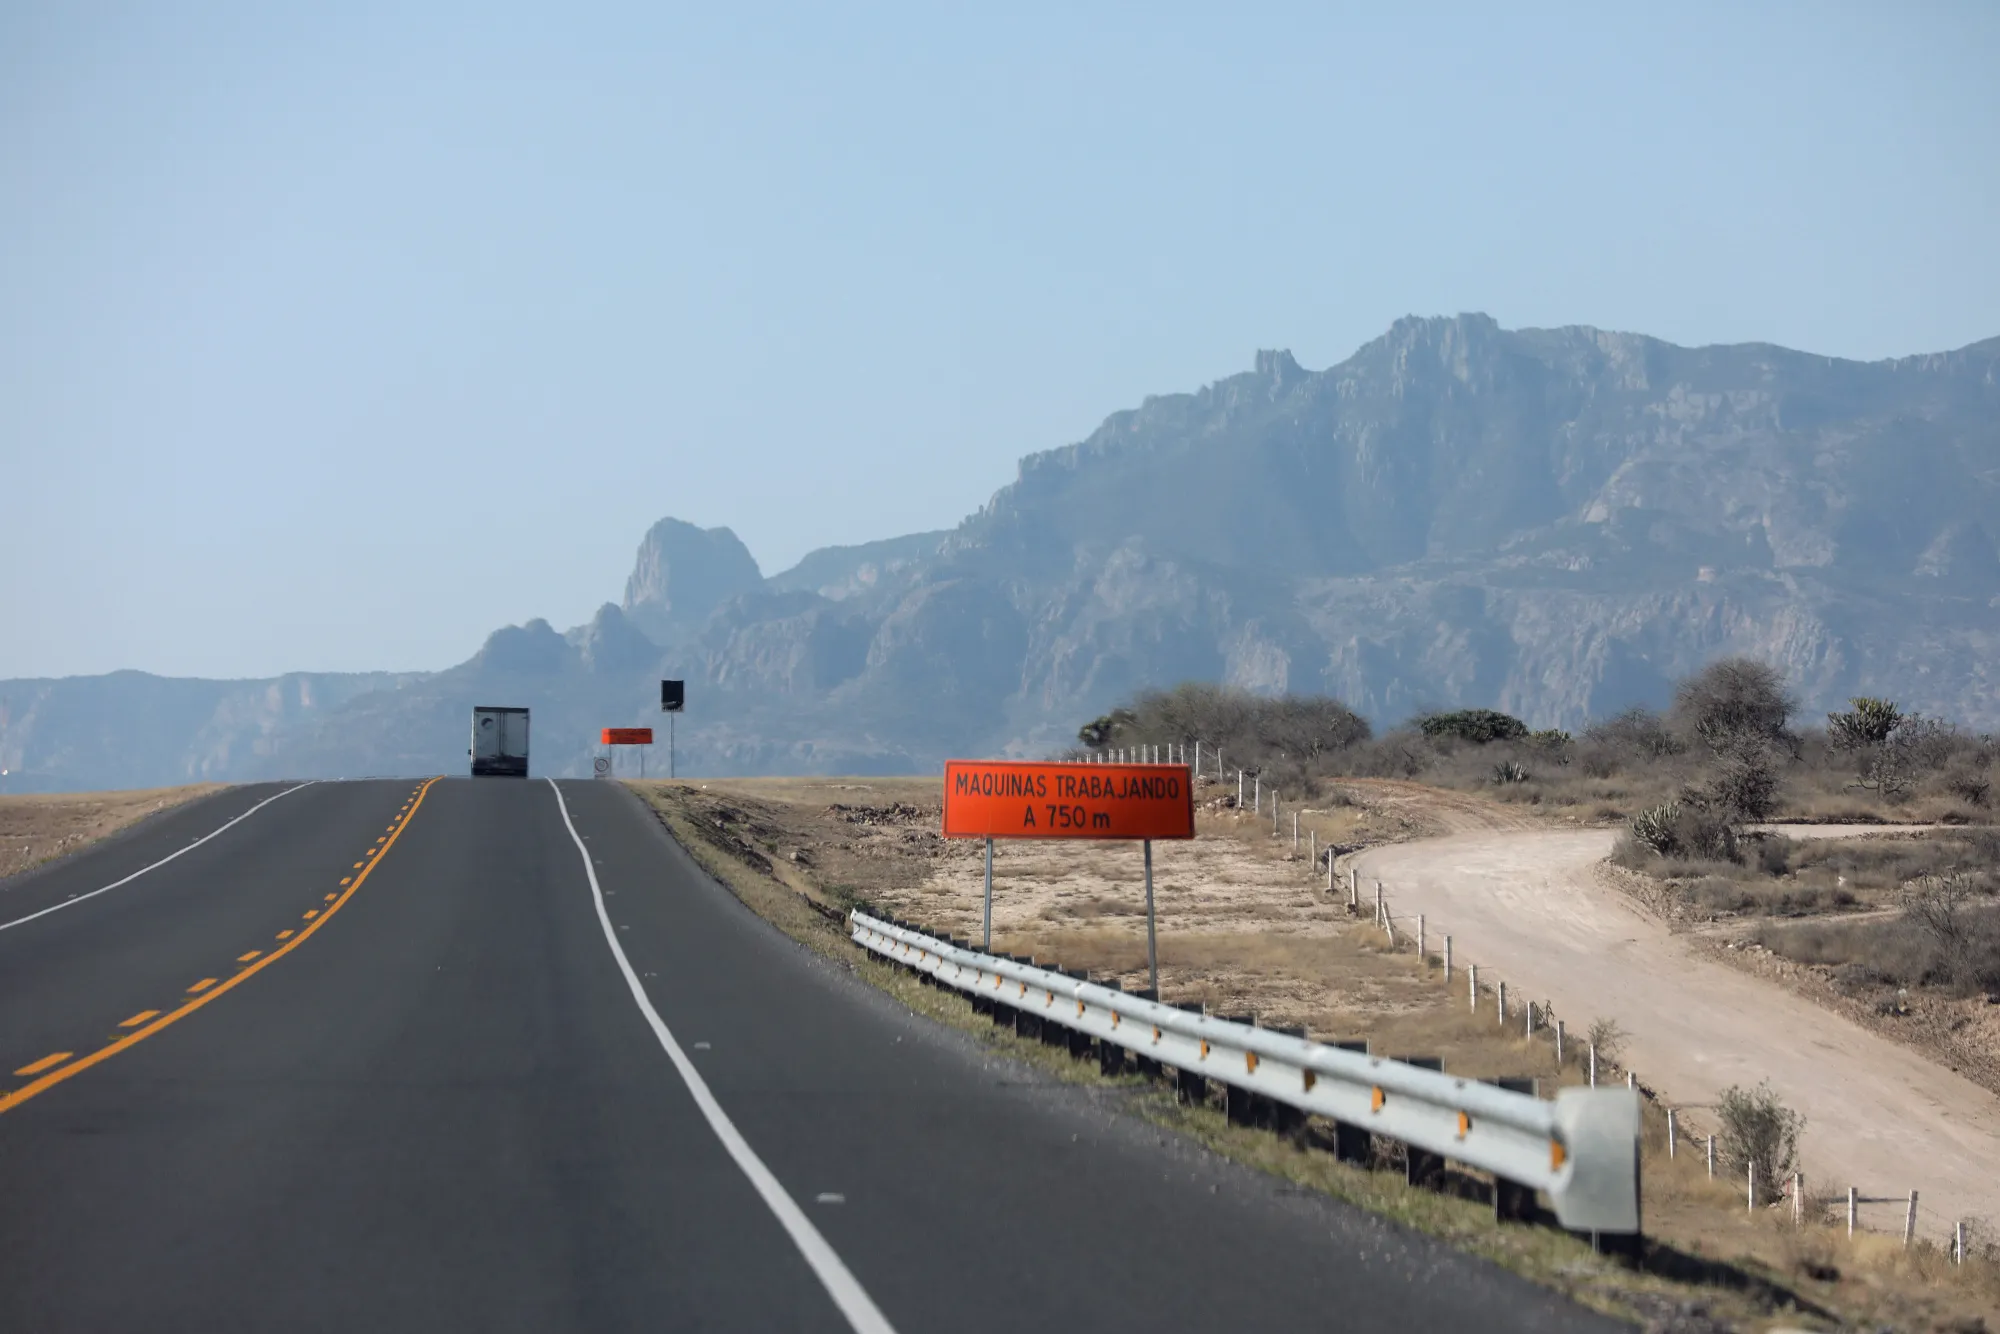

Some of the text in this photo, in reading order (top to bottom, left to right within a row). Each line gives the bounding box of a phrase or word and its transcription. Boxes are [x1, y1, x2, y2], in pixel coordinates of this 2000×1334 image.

[955, 772, 1180, 800] MAQUINAS TRABAJANDO
[1023, 804, 1111, 829] A 750 m
